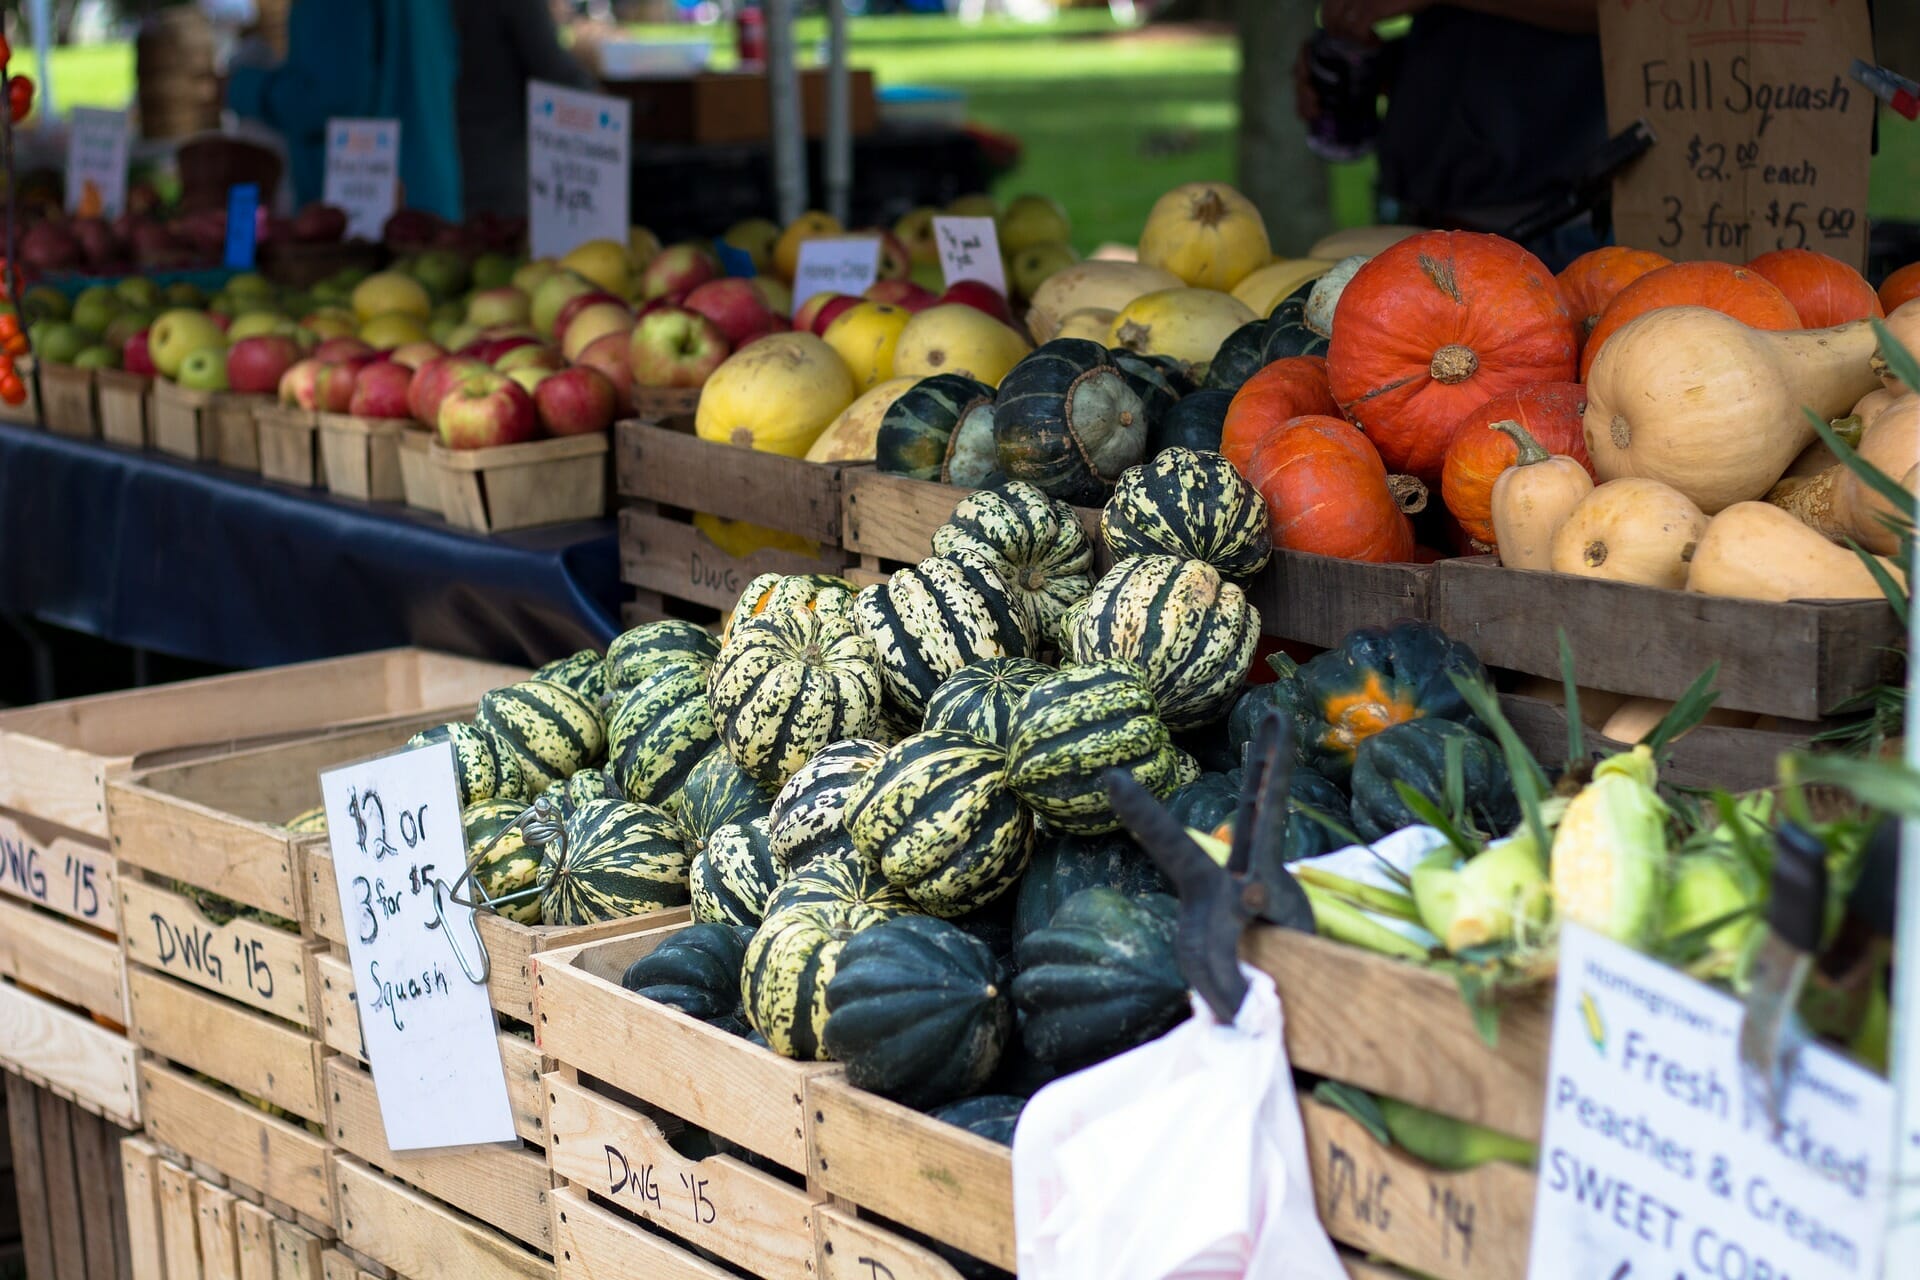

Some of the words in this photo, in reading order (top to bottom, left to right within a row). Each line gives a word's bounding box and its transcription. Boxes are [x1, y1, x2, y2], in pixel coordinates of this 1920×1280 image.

[1641, 58, 1713, 111] Fall
[1724, 55, 1851, 138] Squash
[1762, 159, 1818, 188] each
[1657, 195, 1685, 247] 3
[1701, 202, 1752, 248] for
[348, 784, 399, 862] $2
[399, 803, 429, 850] or
[0, 835, 48, 902] WG
[65, 854, 99, 918] '15
[352, 875, 379, 946] 3
[375, 877, 403, 921] for
[150, 911, 223, 984] DWG
[234, 935, 275, 999] '15
[370, 959, 450, 1033] Squash
[1622, 1028, 1730, 1120] Fresh
[603, 1144, 662, 1211] DWG
[679, 1171, 716, 1224] '15
[1548, 1147, 1683, 1250] SWEET
[1556, 1076, 1697, 1180] Peaches
[1706, 1153, 1733, 1199] &
[1745, 1175, 1860, 1271] Cream
